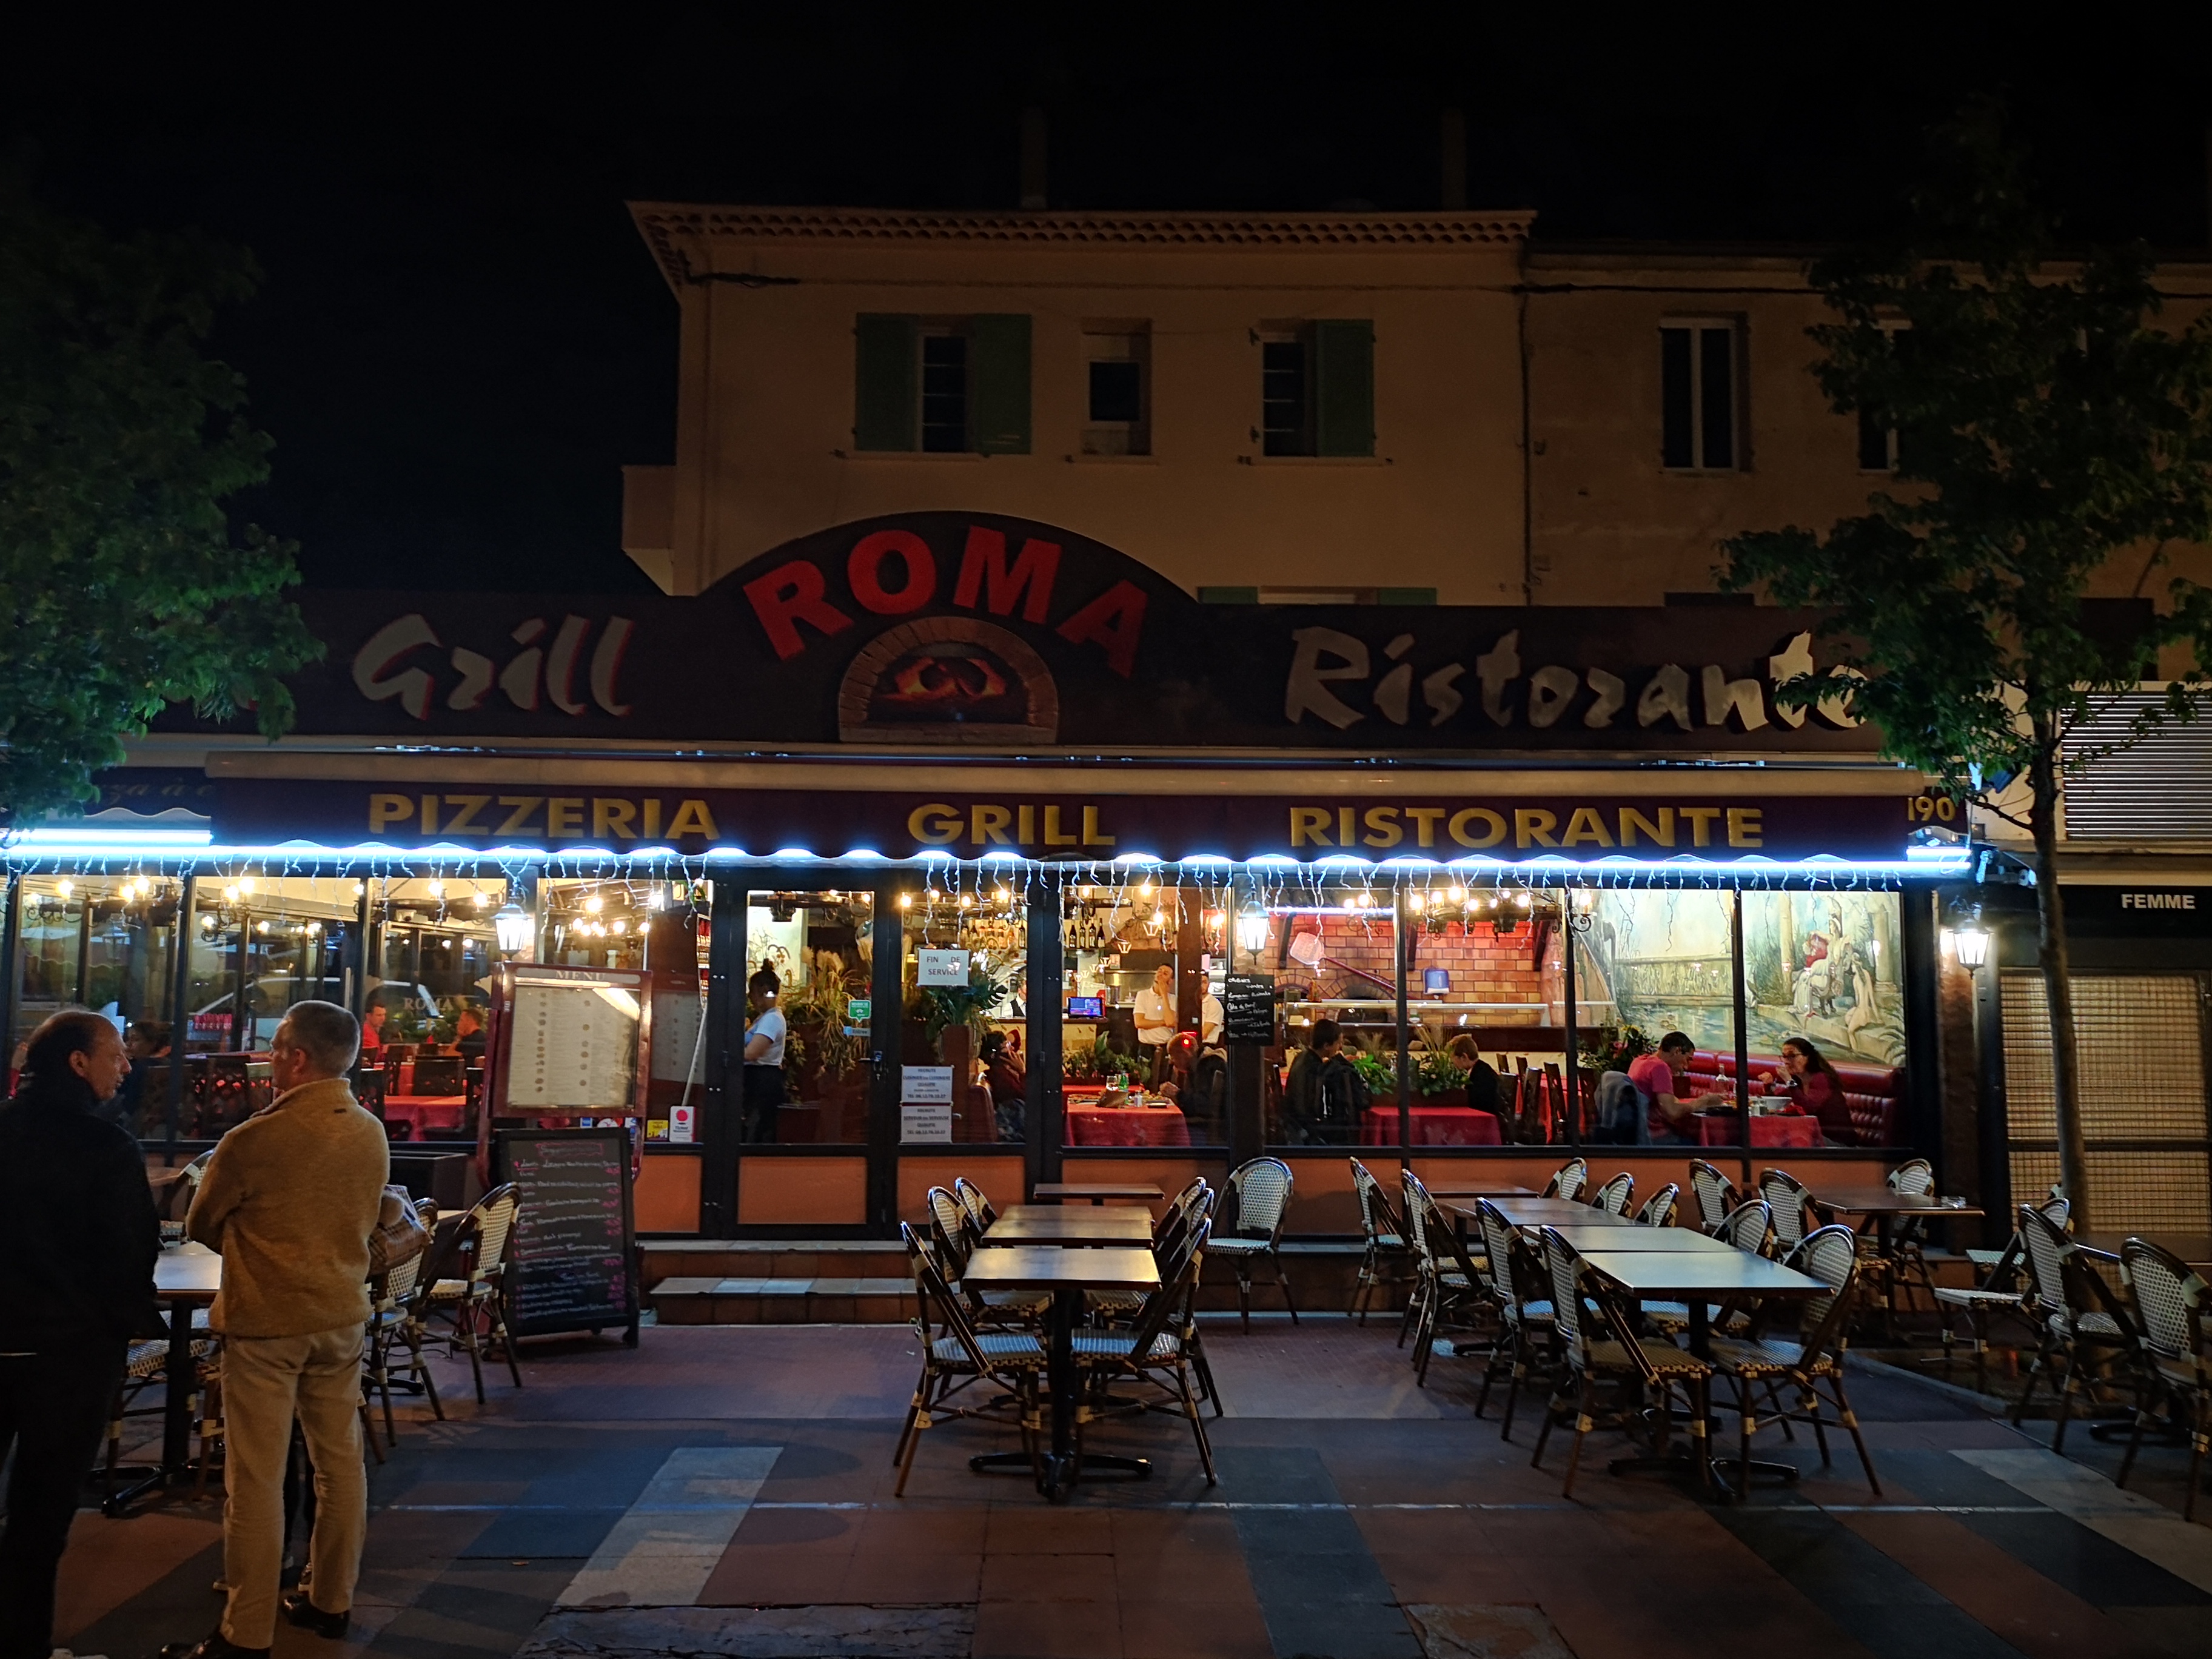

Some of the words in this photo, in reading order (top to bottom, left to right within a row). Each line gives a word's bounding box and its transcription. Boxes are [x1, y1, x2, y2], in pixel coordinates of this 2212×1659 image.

[742, 525, 1148, 679] ROMA
[352, 613, 635, 721] Grill
[1284, 624, 1871, 732] Ristorante
[369, 793, 720, 840] PIZZERIA
[907, 803, 1115, 846] GRILL
[1290, 806, 1764, 850] RISTORANTE
[1907, 796, 1956, 822] 190
[2121, 893, 2196, 910] FEMME
[555, 970, 606, 981] MENU
